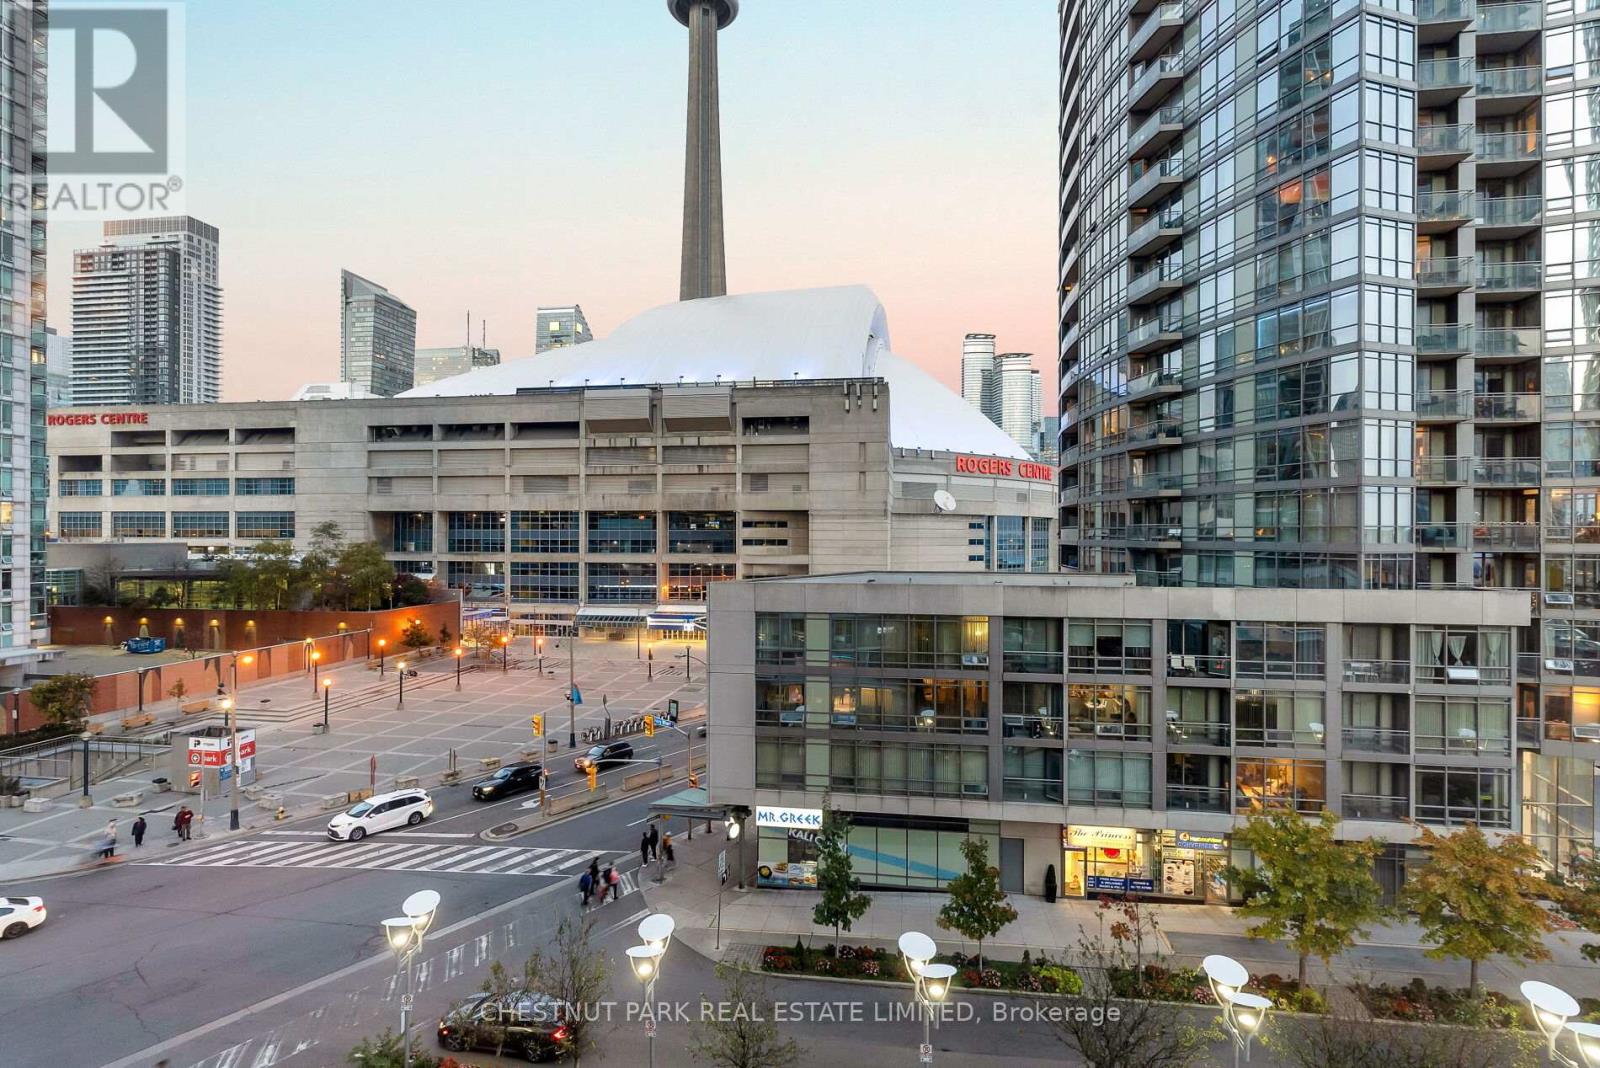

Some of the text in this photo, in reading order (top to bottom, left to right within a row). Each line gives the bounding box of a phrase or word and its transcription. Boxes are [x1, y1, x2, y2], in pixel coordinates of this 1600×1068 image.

[48, 413, 148, 426] ROGERS CENTRE
[956, 455, 1052, 481] ROGERS CENTRE
[779, 812, 821, 825] GREEK
[788, 828, 813, 843] KALI
